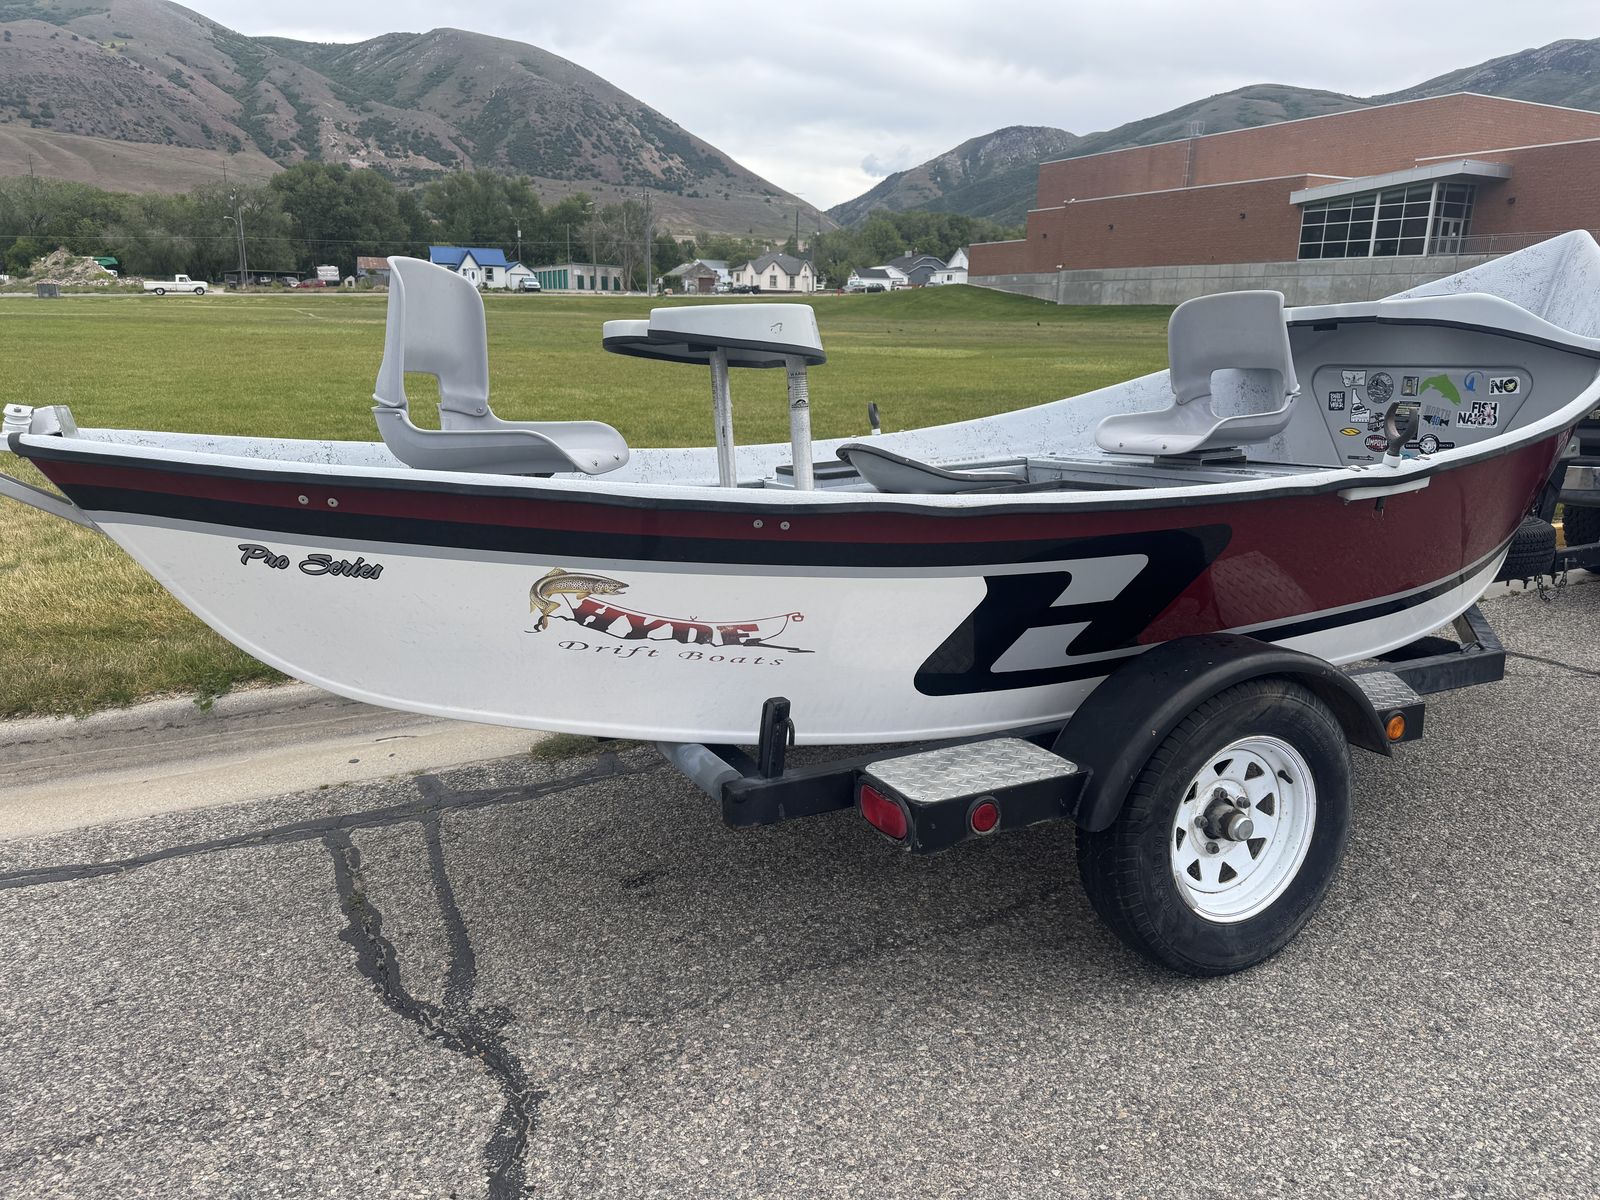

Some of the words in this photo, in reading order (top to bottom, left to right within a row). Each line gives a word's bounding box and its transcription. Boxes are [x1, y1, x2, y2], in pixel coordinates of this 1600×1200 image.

[1424, 404, 1452, 419] NORTH
[1471, 401, 1498, 415] FISH
[1431, 414, 1441, 426] 40
[237, 543, 291, 570] Pro
[298, 553, 385, 581] Series
[571, 598, 761, 647] HYDE
[557, 640, 660, 660] Drift
[678, 650, 785, 667] Boats
